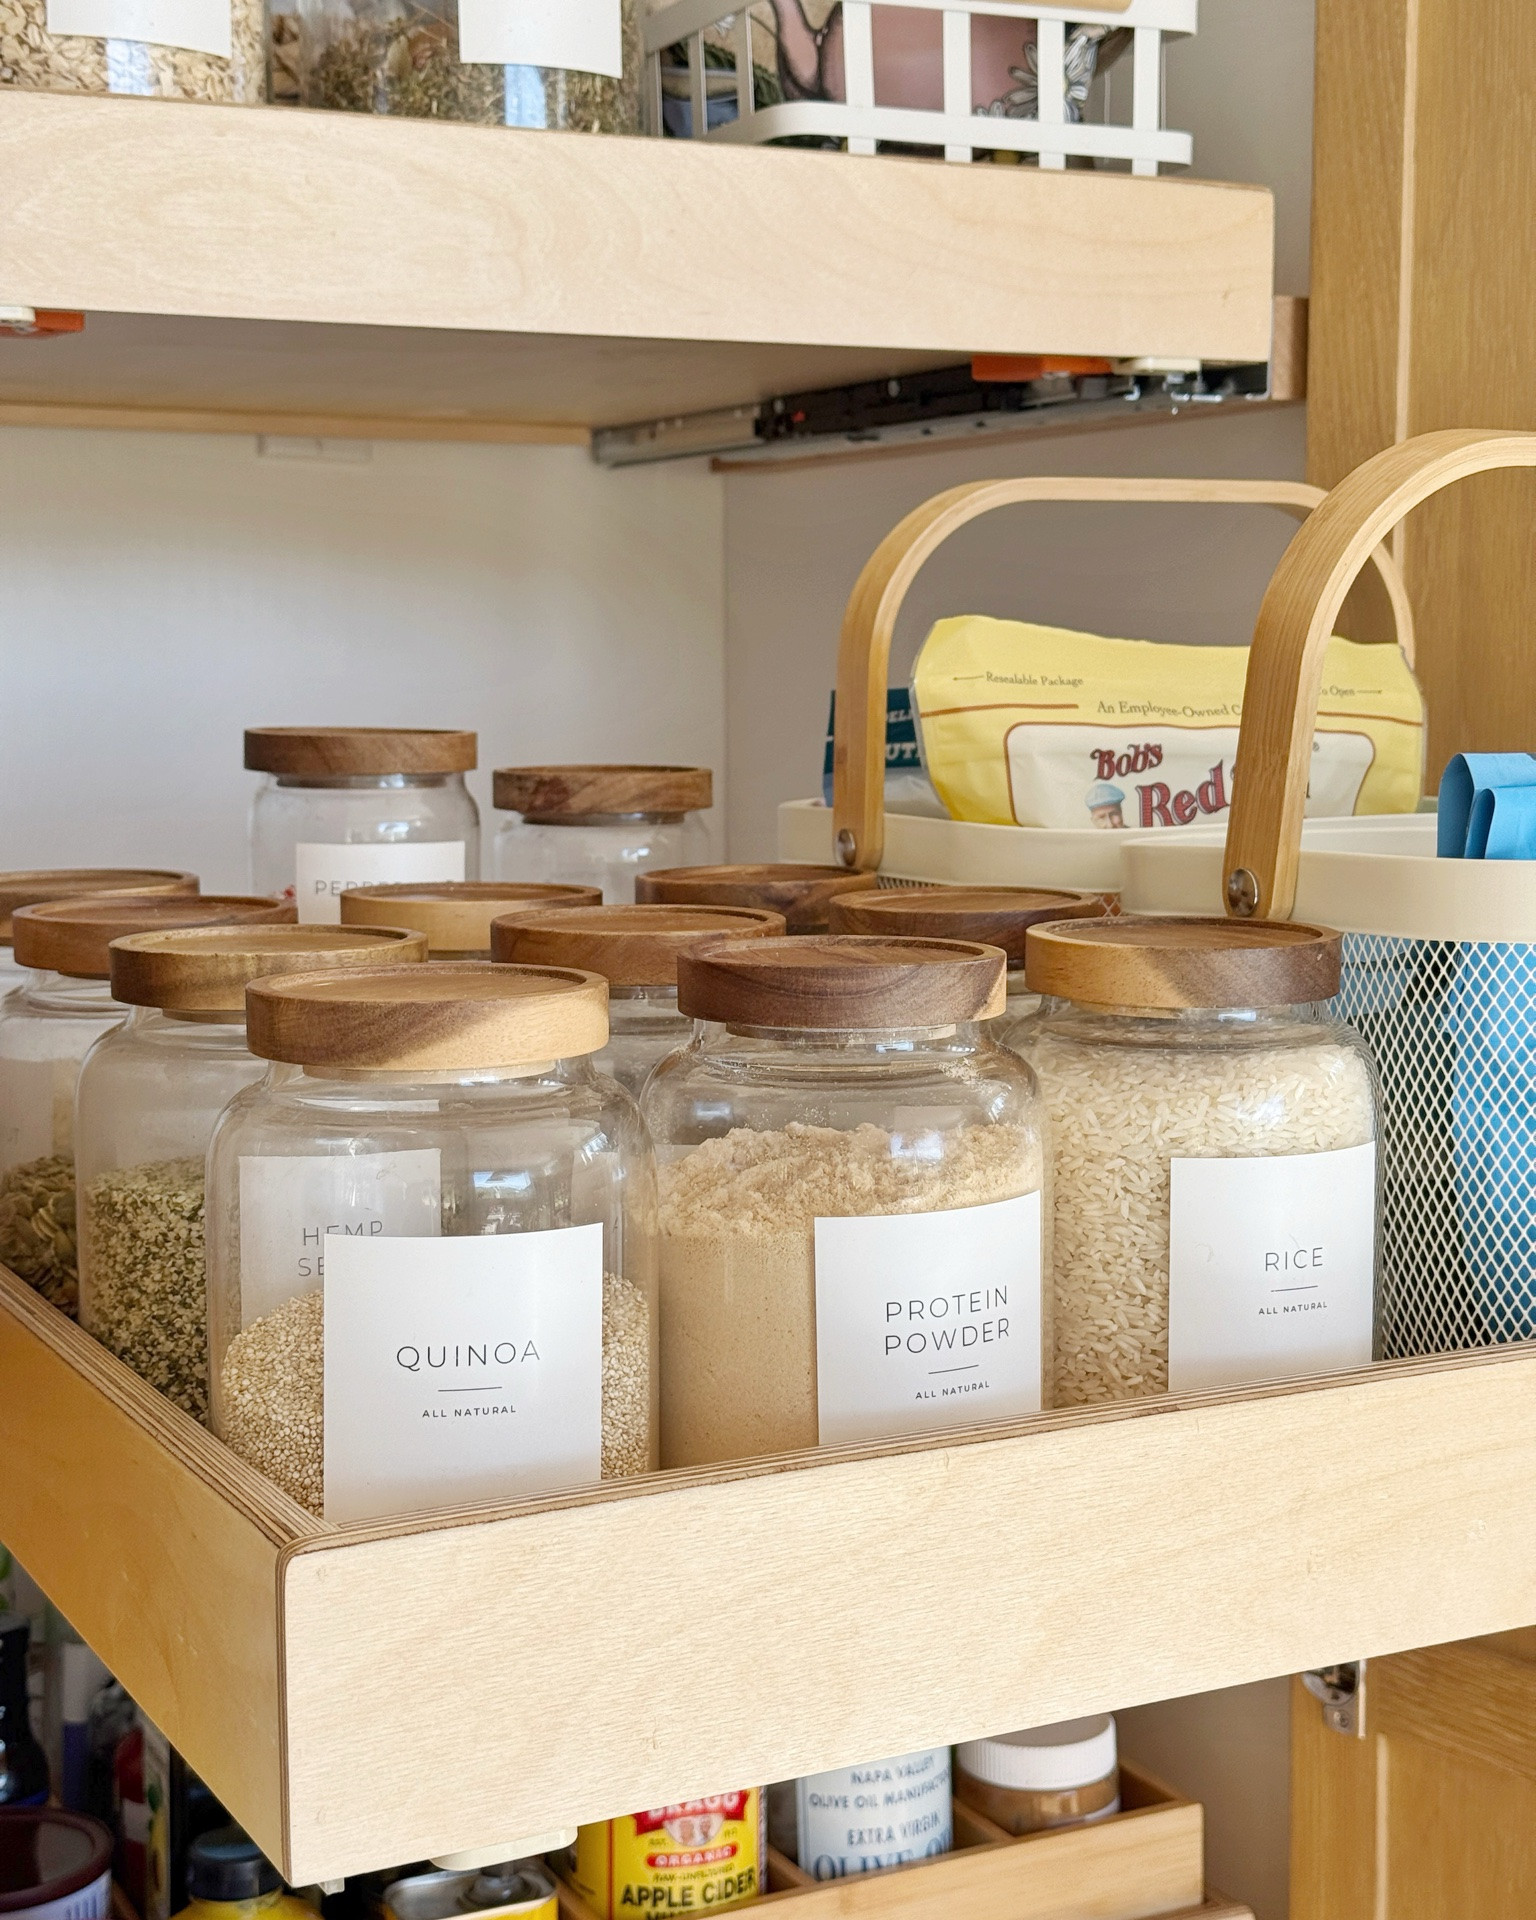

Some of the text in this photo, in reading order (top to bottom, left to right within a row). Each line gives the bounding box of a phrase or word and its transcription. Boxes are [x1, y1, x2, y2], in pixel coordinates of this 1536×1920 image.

[985, 671, 1084, 687] Resealable Package
[1329, 685, 1356, 698] Open
[1097, 701, 1115, 714] An
[1120, 701, 1230, 718] Employee-Owned
[1090, 743, 1163, 781] Bob's
[1135, 759, 1230, 827] Red
[1265, 1247, 1323, 1271] RICE
[886, 1285, 1008, 1323] PROTEIN
[1259, 1301, 1328, 1315] ALL NATURAL
[885, 1318, 1010, 1355] POWDER
[396, 1340, 540, 1372] QUINOA
[915, 1381, 990, 1400] ALL NATURAL
[422, 1405, 516, 1418] ALL NATURAL
[847, 1825, 895, 1846] EXTRA
[622, 1866, 756, 1908] APPLE CIDER
